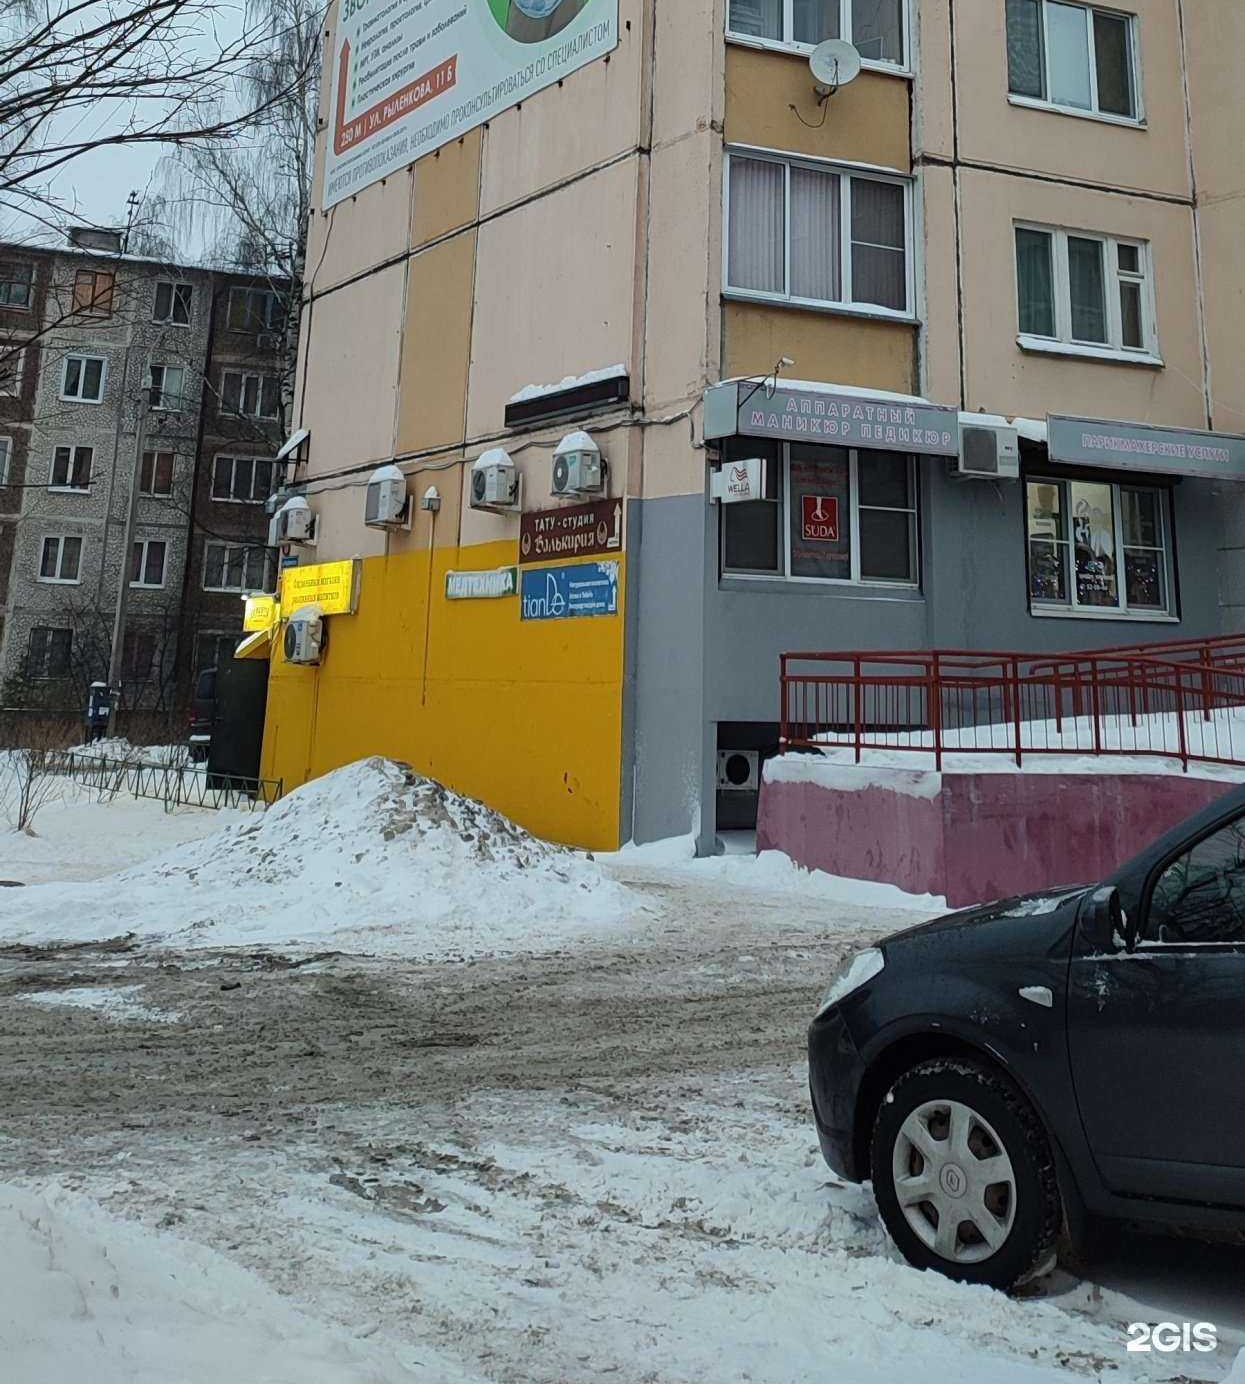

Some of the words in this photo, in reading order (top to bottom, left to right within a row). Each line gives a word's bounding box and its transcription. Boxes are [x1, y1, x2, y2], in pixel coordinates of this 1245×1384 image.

[410, 113, 450, 149] НЕОБХОДИМО
[450, 63, 534, 128] ПРОКОНСУЛЬТИРОВАТЬСЯ
[535, 56, 546, 77] СО
[547, 19, 611, 68] СПЕЦИАЛИСТОМ
[340, 128, 354, 147] 250
[786, 398, 916, 425] АППАРАТНЫЙ
[751, 411, 850, 436] МАНИКЮР
[861, 423, 951, 445] ПЕДИКЮР
[1081, 433, 1185, 457] ПАРИКМАХЕРСКИЕ
[727, 482, 750, 494] WELLA
[535, 516, 555, 532] ТАТУ
[534, 531, 595, 554] Валькирия
